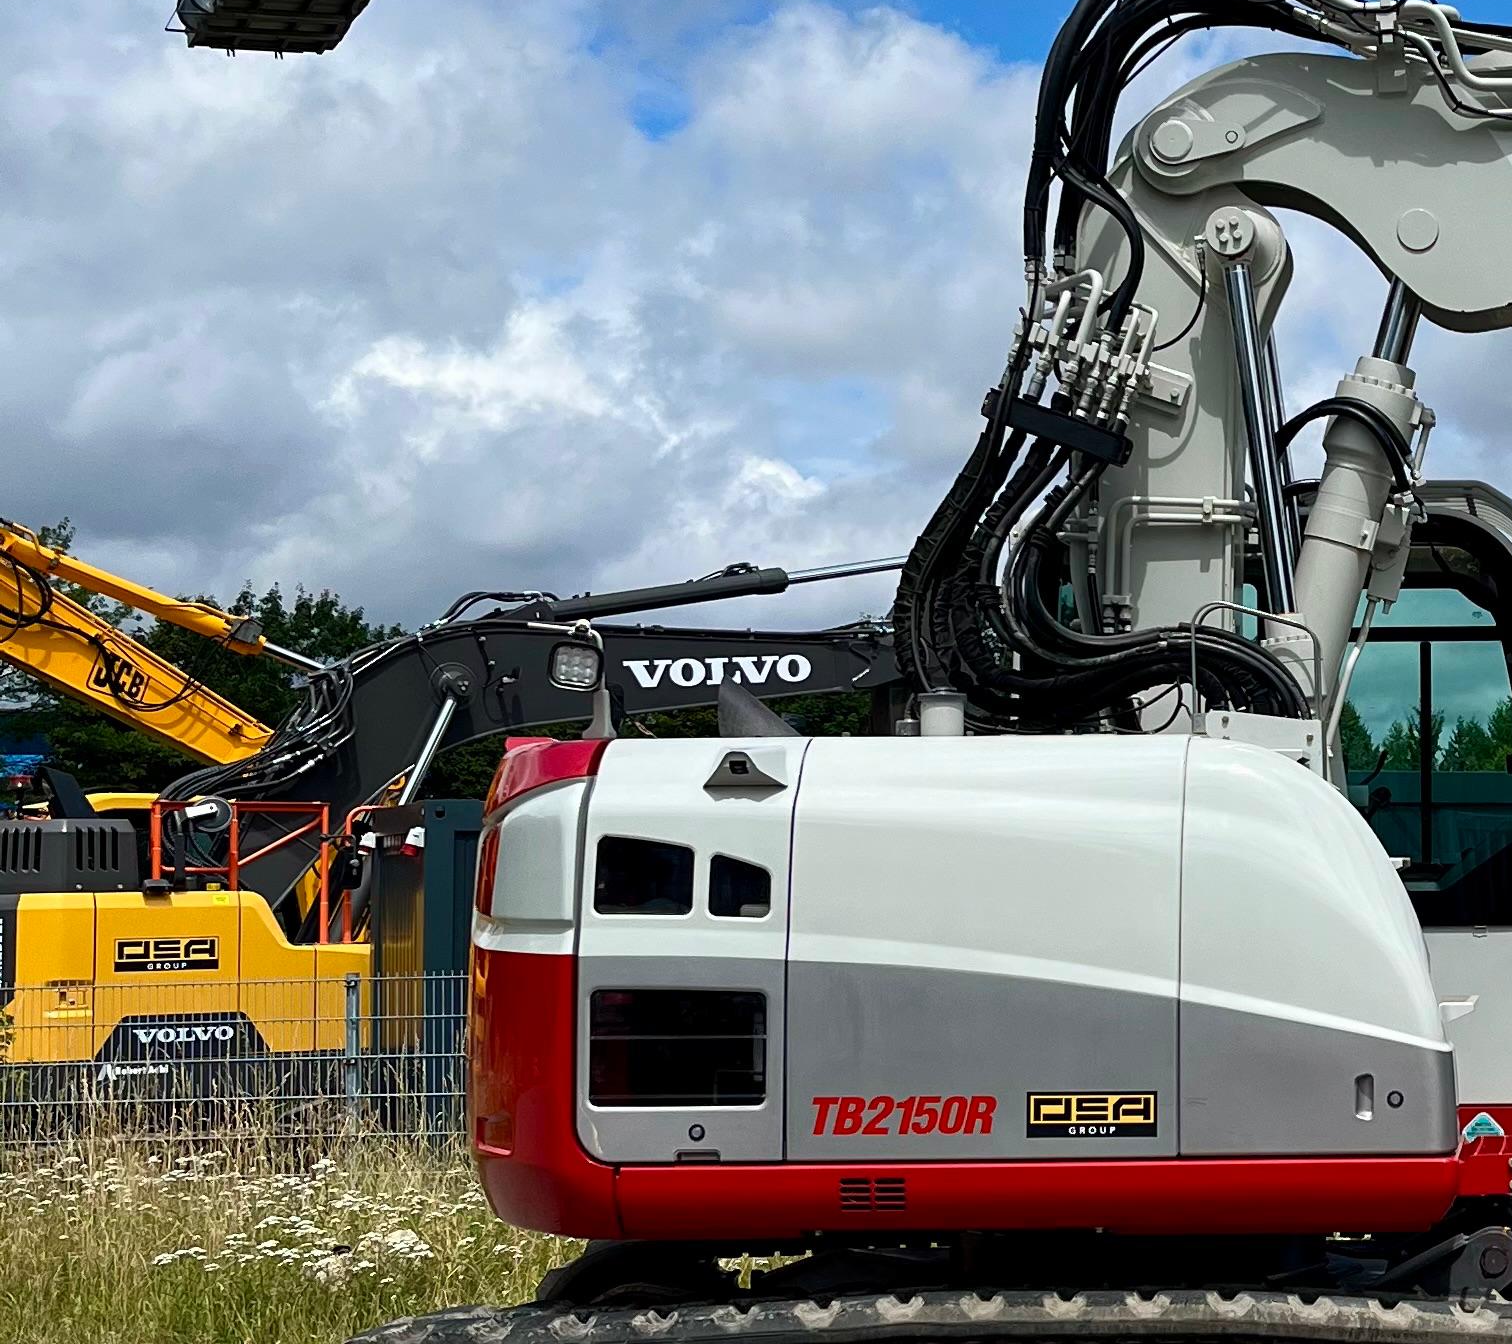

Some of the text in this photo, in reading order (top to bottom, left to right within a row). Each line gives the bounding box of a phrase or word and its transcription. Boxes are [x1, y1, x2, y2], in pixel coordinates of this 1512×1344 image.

[622, 654, 812, 688] VOLVO
[147, 962, 187, 970] GROUP
[133, 1025, 234, 1044] VOLVO
[811, 1095, 998, 1136] TB2150R
[1068, 1126, 1116, 1135] GROUP
